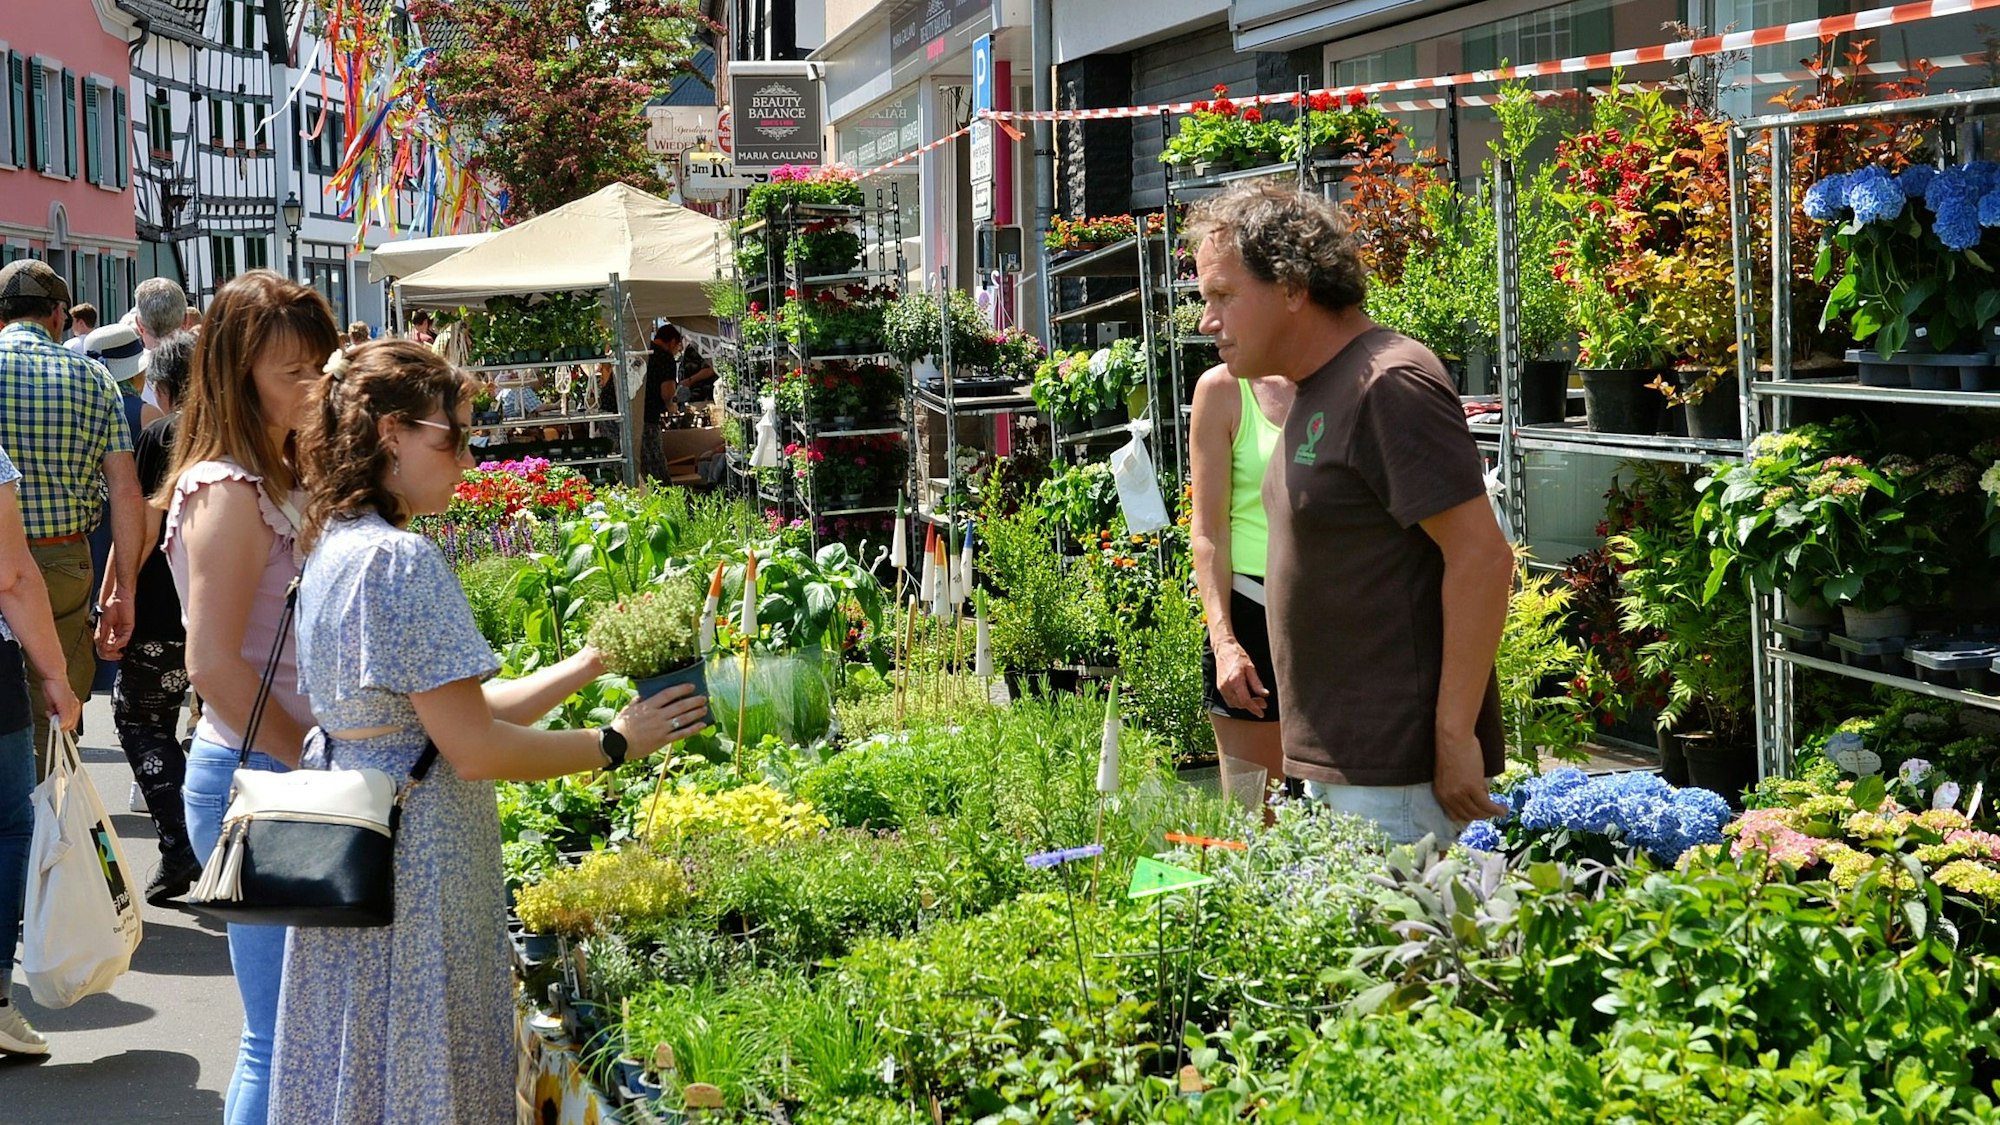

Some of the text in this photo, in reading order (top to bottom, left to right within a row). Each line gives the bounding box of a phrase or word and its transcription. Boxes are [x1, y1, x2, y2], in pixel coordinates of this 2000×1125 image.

[976, 48, 987, 109] P
[752, 96, 802, 108] BEAUTY
[748, 107, 807, 119] BALANCE
[738, 150, 819, 161] MARIA GALLAND
